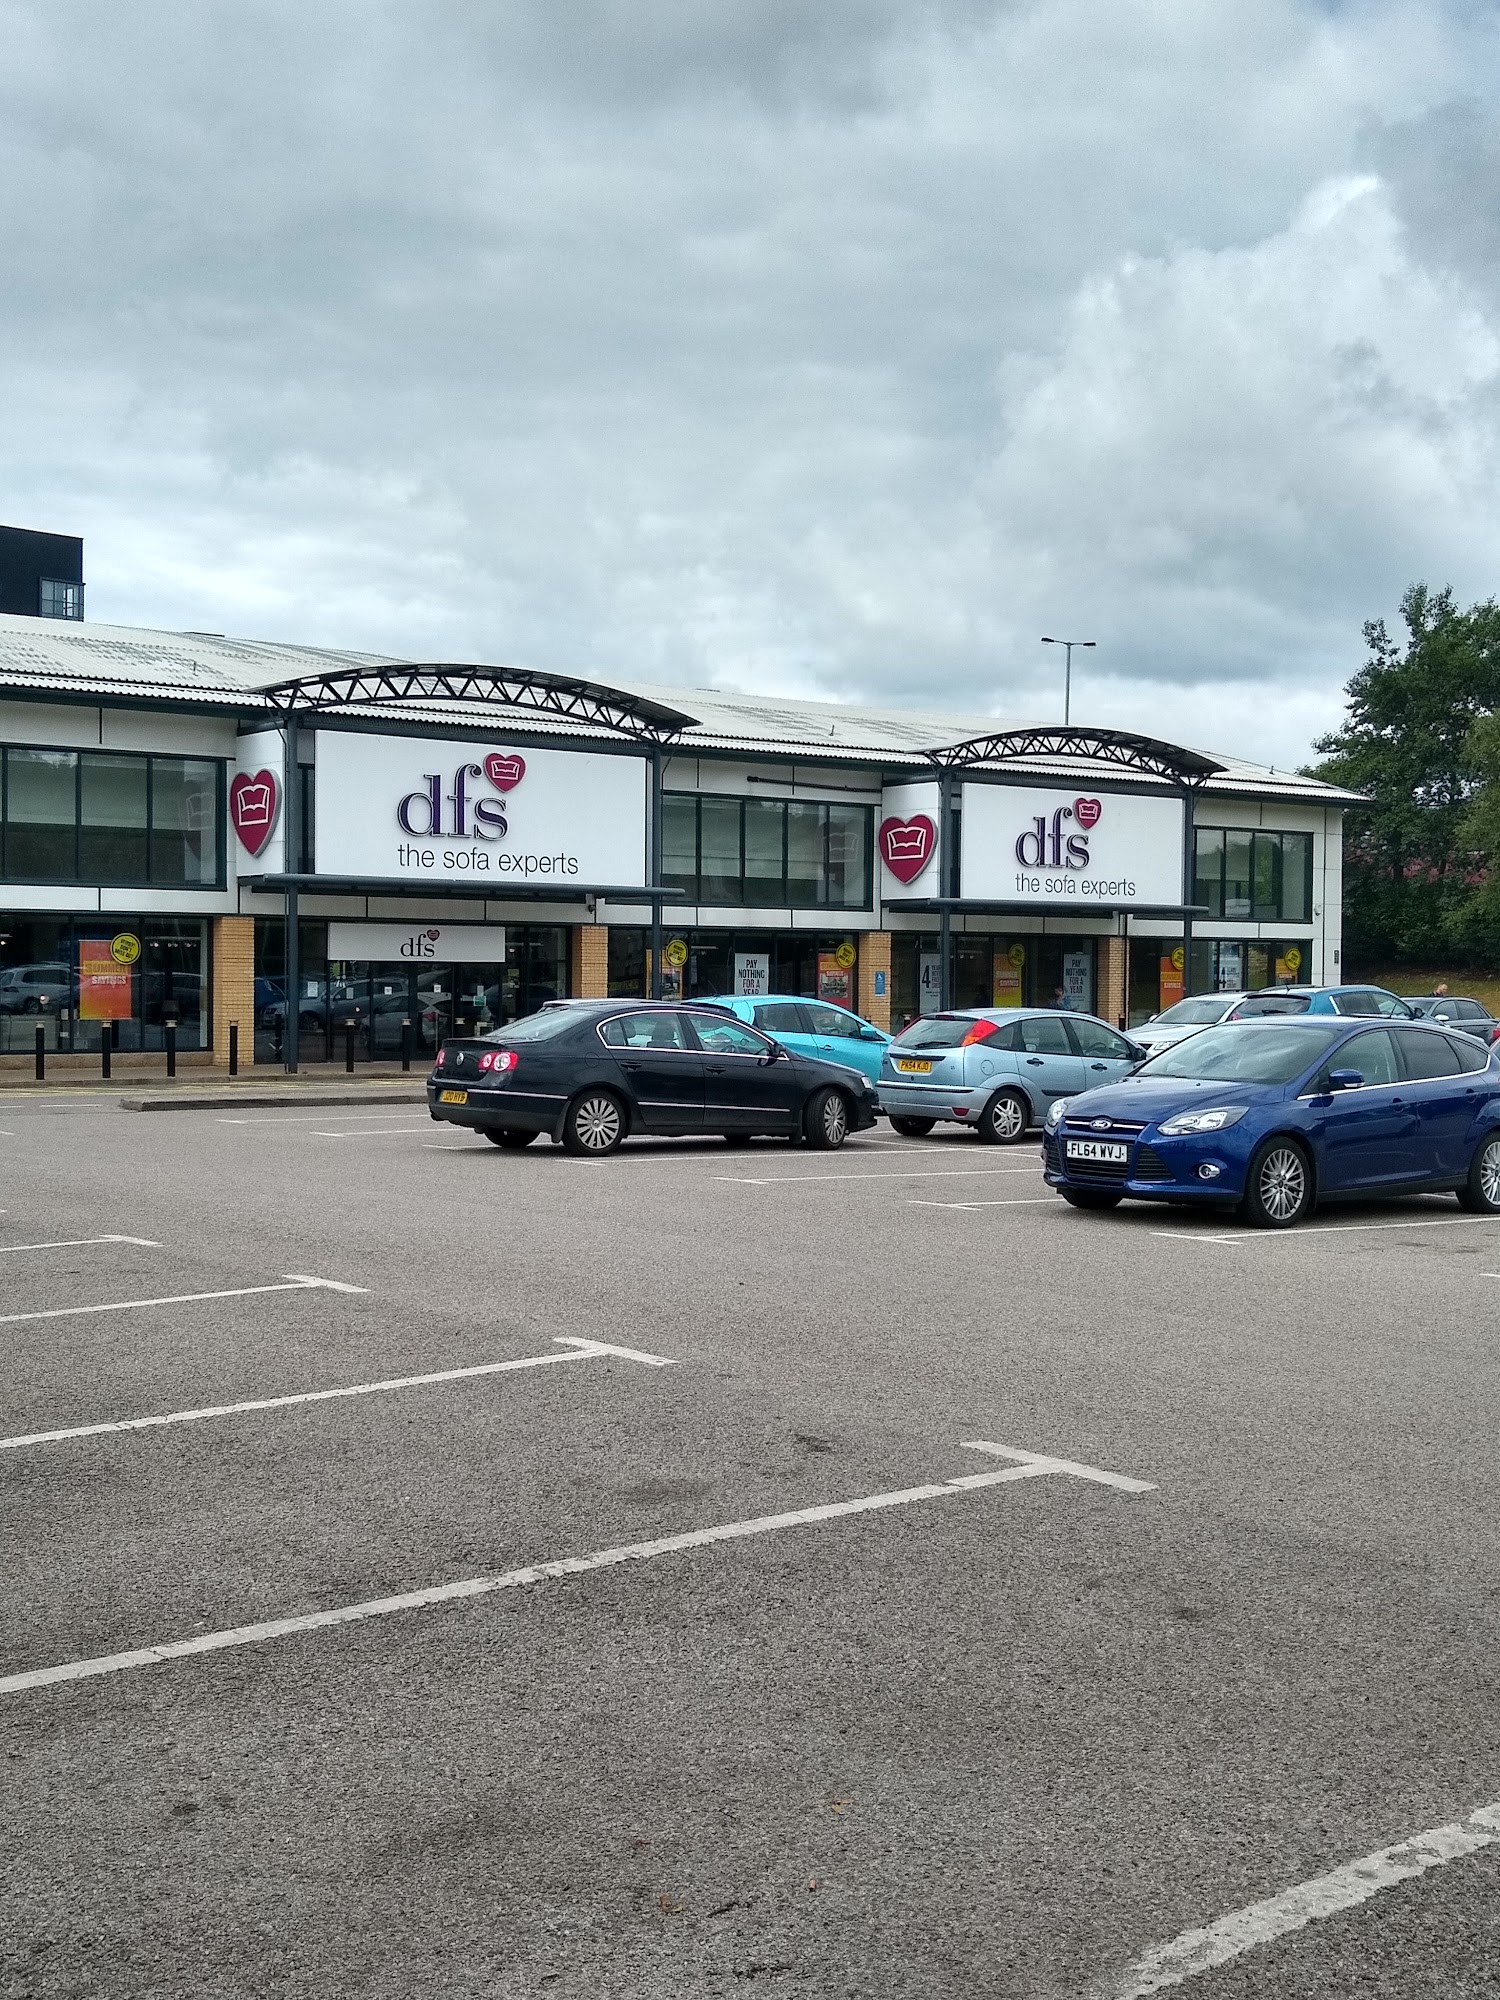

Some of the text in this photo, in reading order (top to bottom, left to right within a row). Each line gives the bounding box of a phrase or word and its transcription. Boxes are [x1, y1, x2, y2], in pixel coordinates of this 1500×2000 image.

[397, 763, 510, 842] dfs
[1015, 806, 1090, 870] dfs
[398, 843, 579, 878] the sofa experts
[1015, 872, 1136, 899] the sofa experts
[400, 933, 435, 958] dfs
[85, 963, 128, 973] SUMMER
[745, 959, 758, 969] PAY
[1071, 959, 1082, 968] PAY
[738, 969, 766, 979] NOTHING
[921, 964, 931, 989] 4
[1065, 967, 1088, 977] NOTHING
[91, 975, 127, 985] SAVINGS
[742, 978, 761, 989] FOR A
[1069, 976, 1084, 986] FOR A
[1070, 985, 1083, 994] YEAR
[1071, 1143, 1122, 1159] FL64 WVJ
